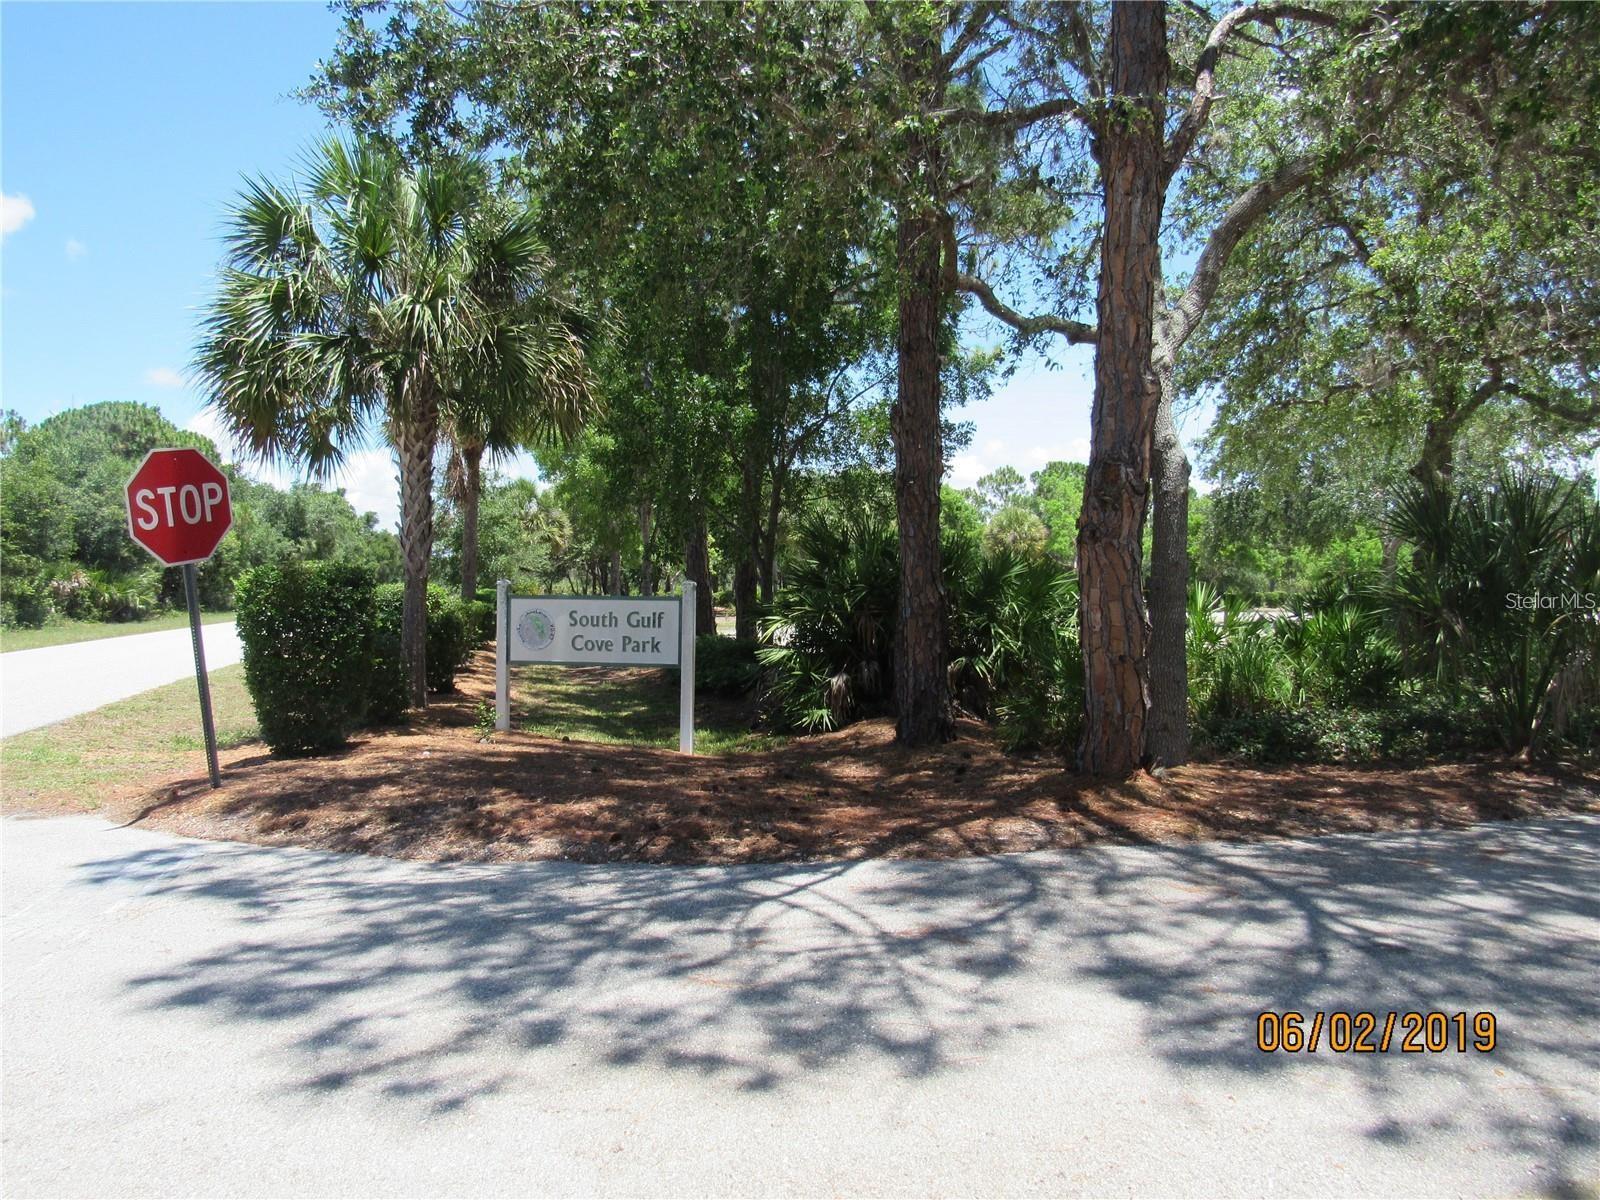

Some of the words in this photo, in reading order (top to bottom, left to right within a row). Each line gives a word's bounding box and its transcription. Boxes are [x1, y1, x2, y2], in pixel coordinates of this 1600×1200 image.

[136, 482, 223, 531] STOP
[568, 610, 618, 628] South
[626, 611, 665, 629] Gulf
[571, 635, 614, 652] Cove
[622, 636, 662, 653] Park
